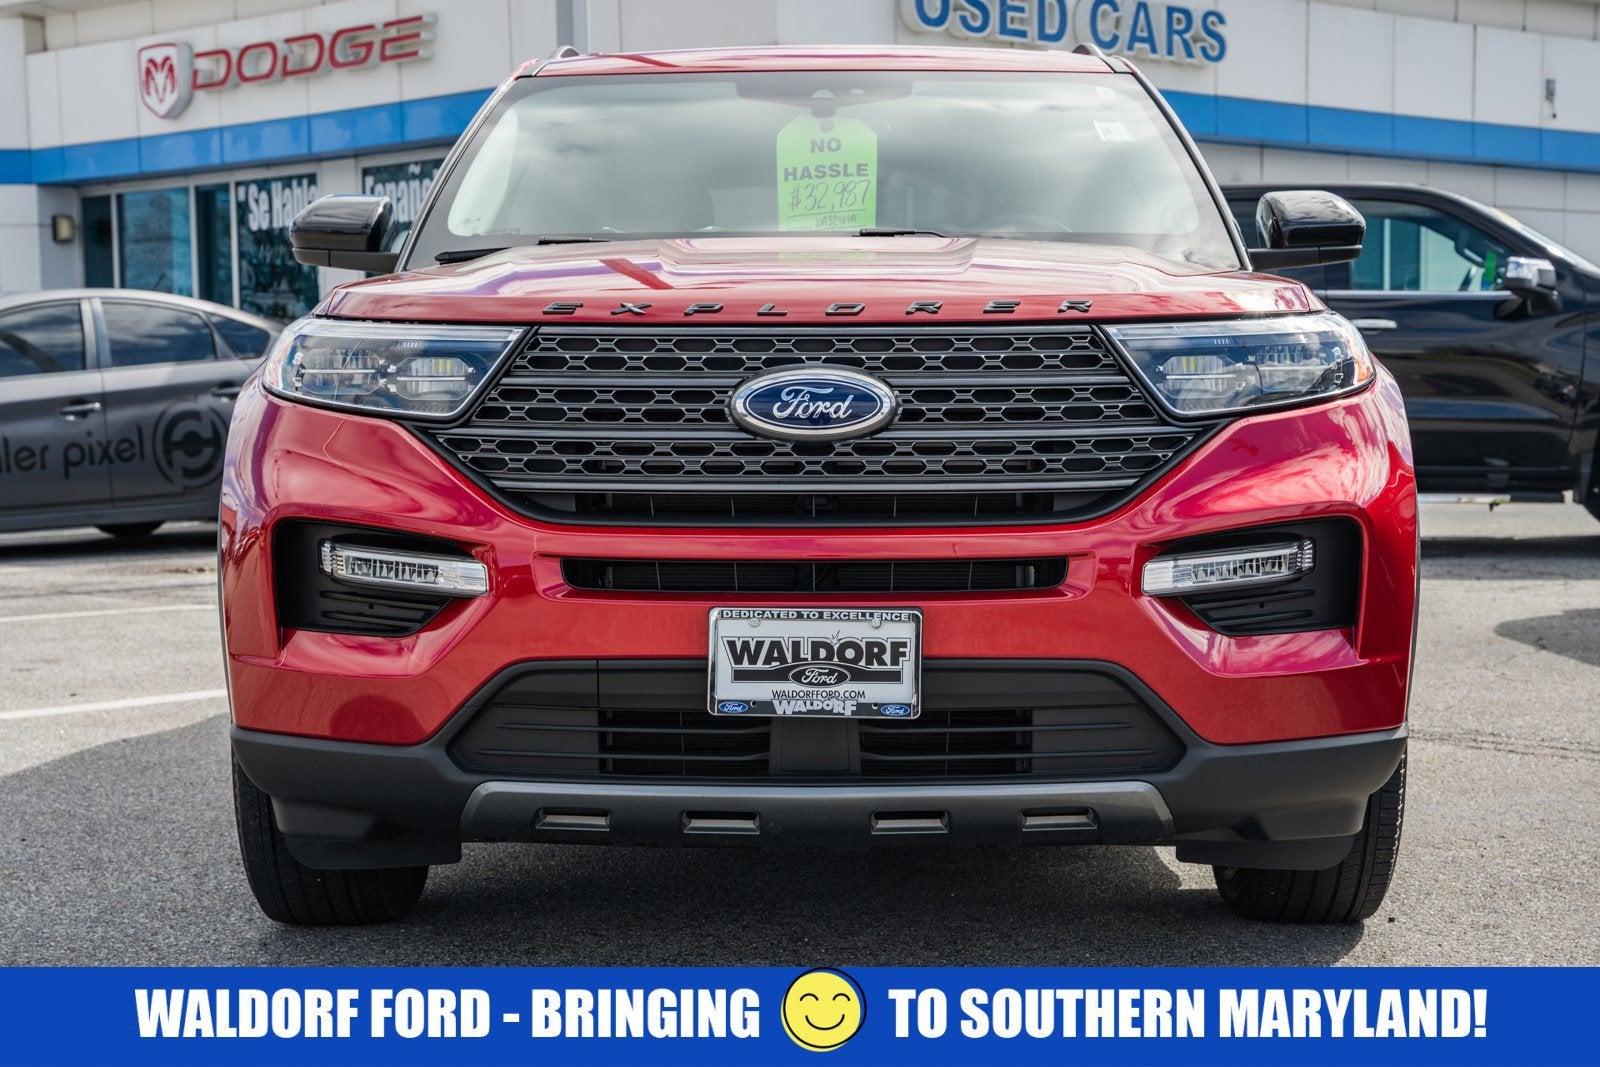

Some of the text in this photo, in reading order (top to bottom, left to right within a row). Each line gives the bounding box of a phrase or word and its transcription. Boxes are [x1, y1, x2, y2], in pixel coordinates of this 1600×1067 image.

[915, 0, 1227, 63] USED CARS
[193, 15, 432, 91] DODGE
[811, 138, 842, 153] NO
[784, 163, 869, 182] HASSLE
[788, 180, 871, 212] $32,987
[542, 301, 1094, 316] EXPLORER
[772, 386, 852, 420] Ford
[0, 425, 144, 479] ler pixel
[722, 609, 910, 622] DEDICATED TO EXCELLENCE
[721, 636, 912, 668] WALDORF
[801, 668, 838, 685] Ford
[771, 690, 866, 700] WALDORFFORD.COM
[723, 699, 906, 716] Ford WALDORF Ford
